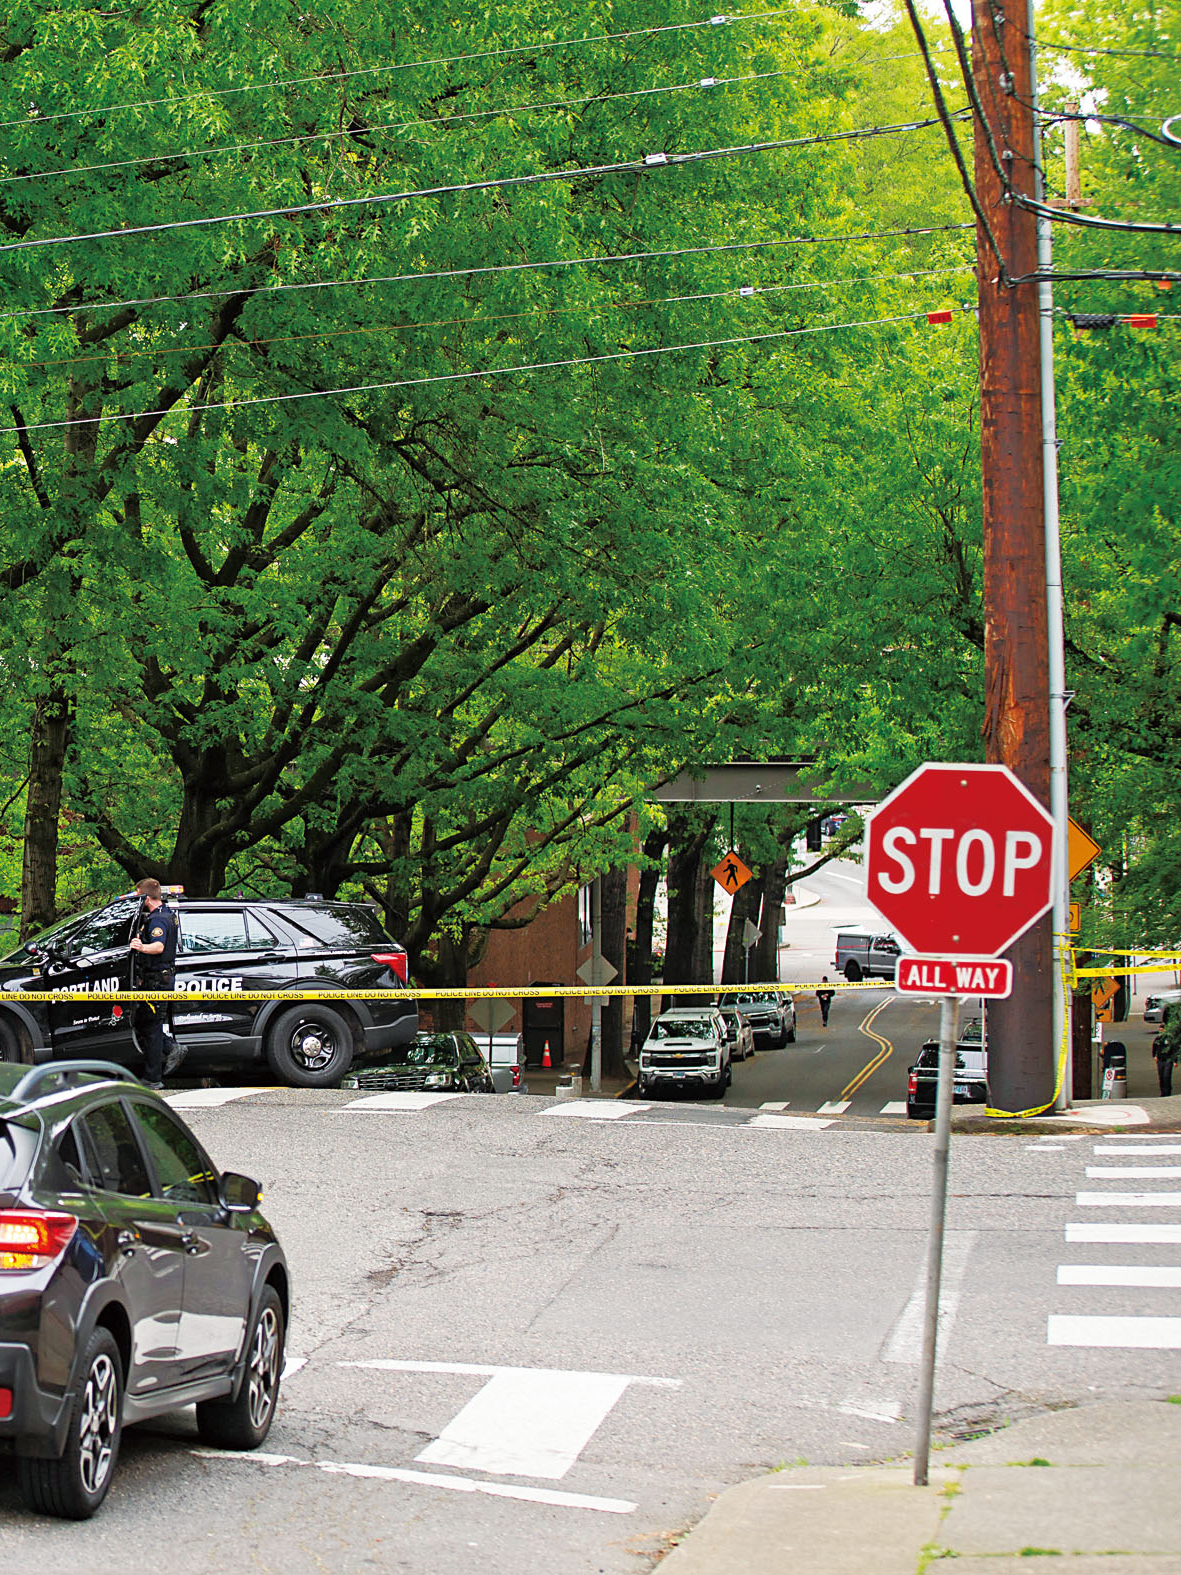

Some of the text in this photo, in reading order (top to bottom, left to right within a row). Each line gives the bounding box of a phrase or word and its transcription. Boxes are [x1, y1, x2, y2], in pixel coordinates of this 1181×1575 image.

[877, 826, 1043, 897] STOP
[174, 977, 243, 992] POLICE
[906, 964, 1000, 989] ALL WAY
